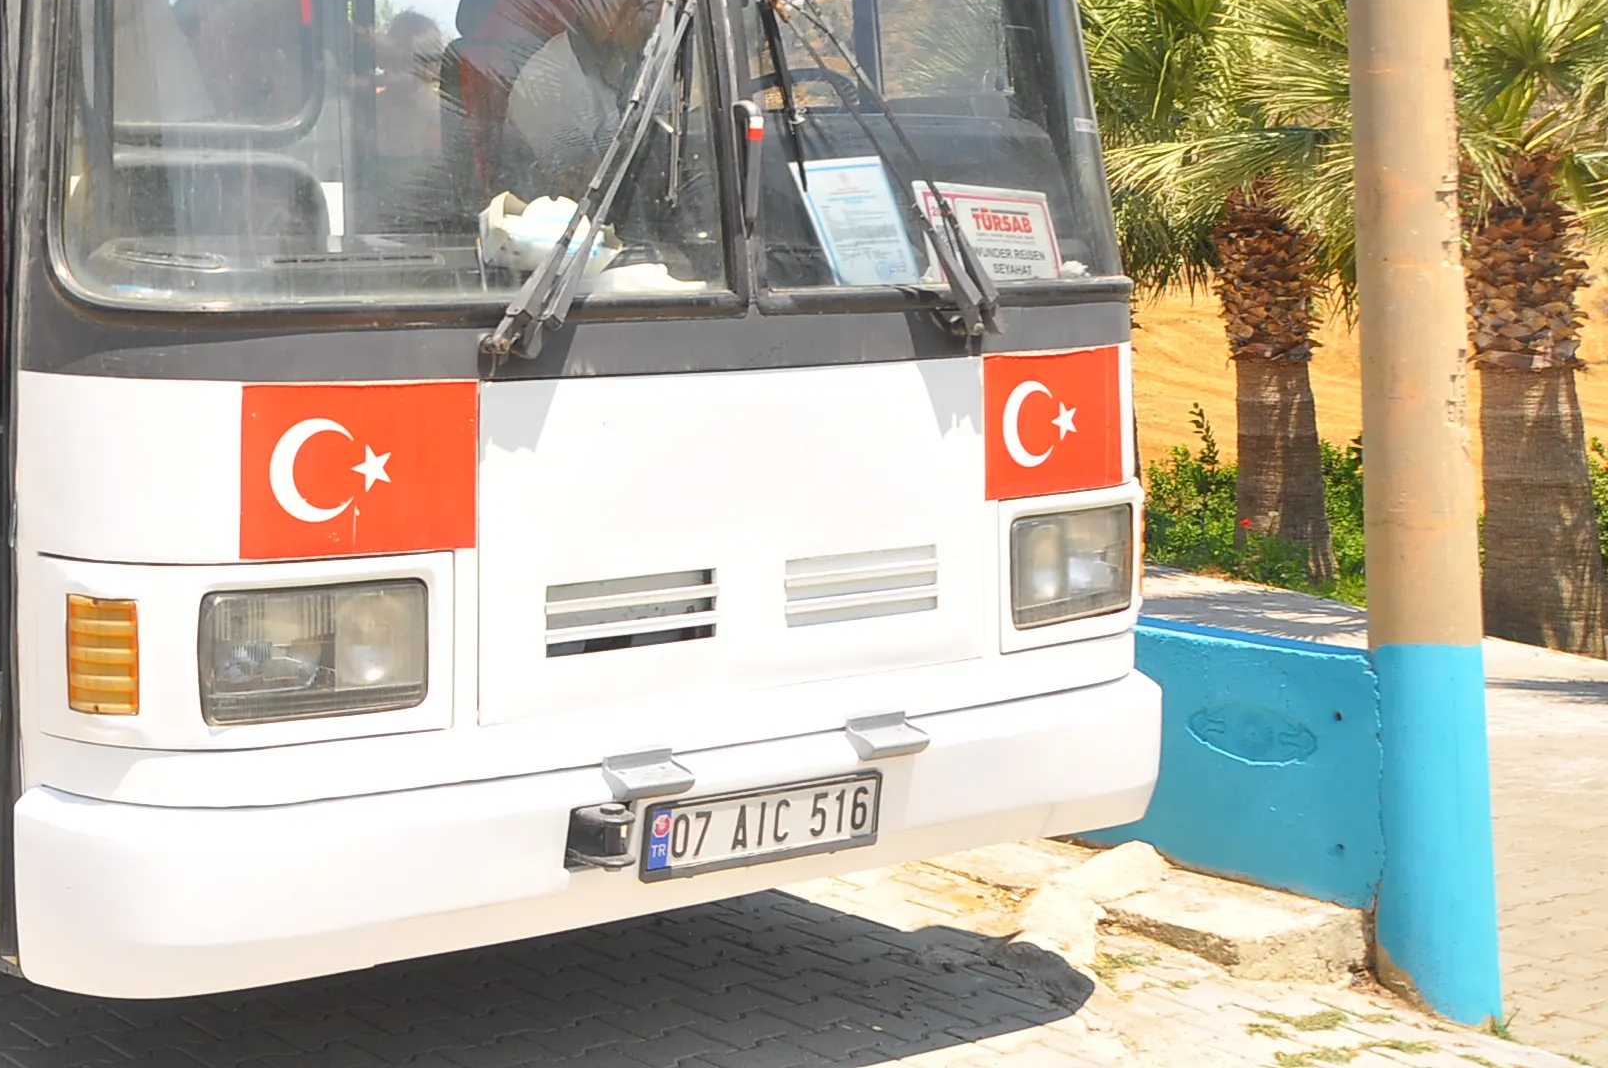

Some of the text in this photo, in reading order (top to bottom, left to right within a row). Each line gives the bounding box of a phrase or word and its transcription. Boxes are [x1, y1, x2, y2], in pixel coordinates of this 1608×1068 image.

[972, 207, 1033, 233] TÜRSAB
[1014, 249, 1046, 261] REISEN
[992, 262, 1033, 275] SEYAHAT
[671, 786, 869, 858] 07 AIC 516
[650, 843, 667, 858] TR
